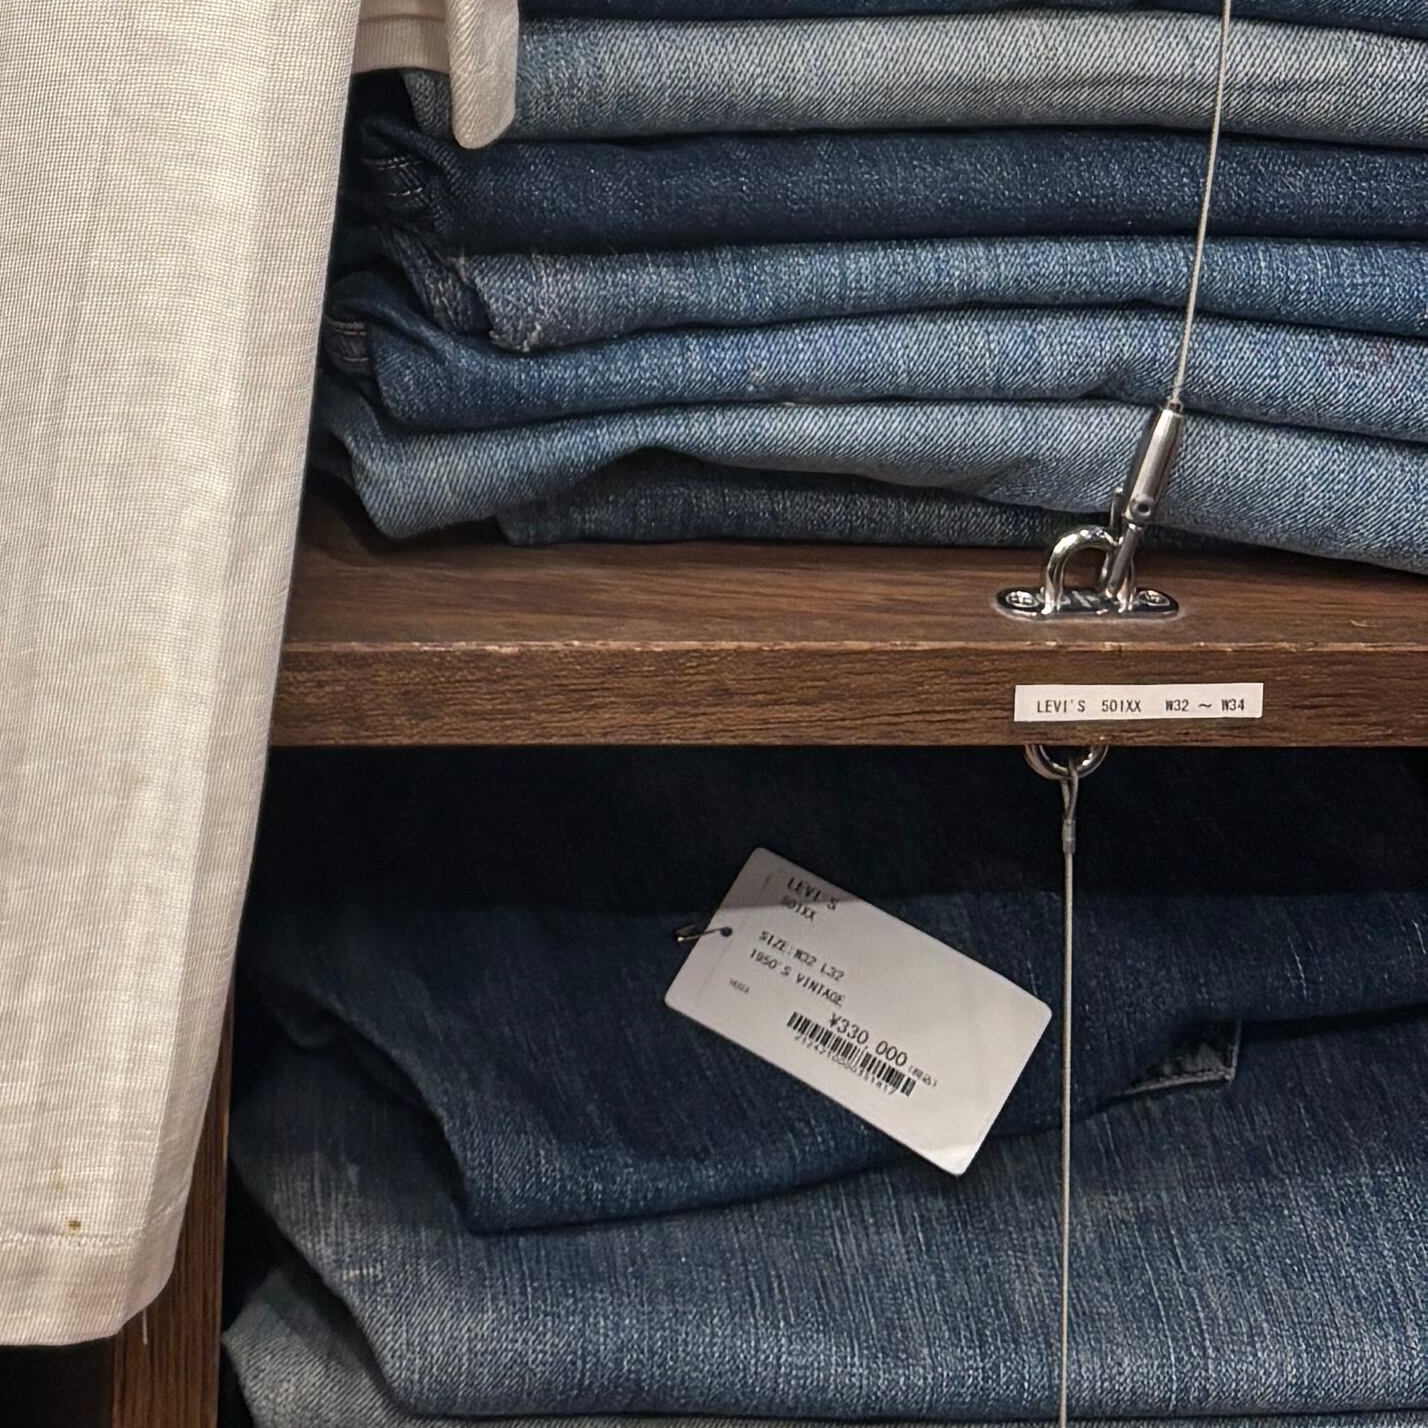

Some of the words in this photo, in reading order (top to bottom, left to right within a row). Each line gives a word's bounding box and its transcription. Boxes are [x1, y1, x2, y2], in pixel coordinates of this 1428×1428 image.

[1036, 699, 1086, 714] LEVI'S
[1101, 698, 1142, 713] 501XX
[1165, 698, 1190, 713] W32
[1220, 698, 1245, 712] W34
[796, 972, 846, 1007] VINTAGE
[829, 1012, 907, 1066] ¥330,000
